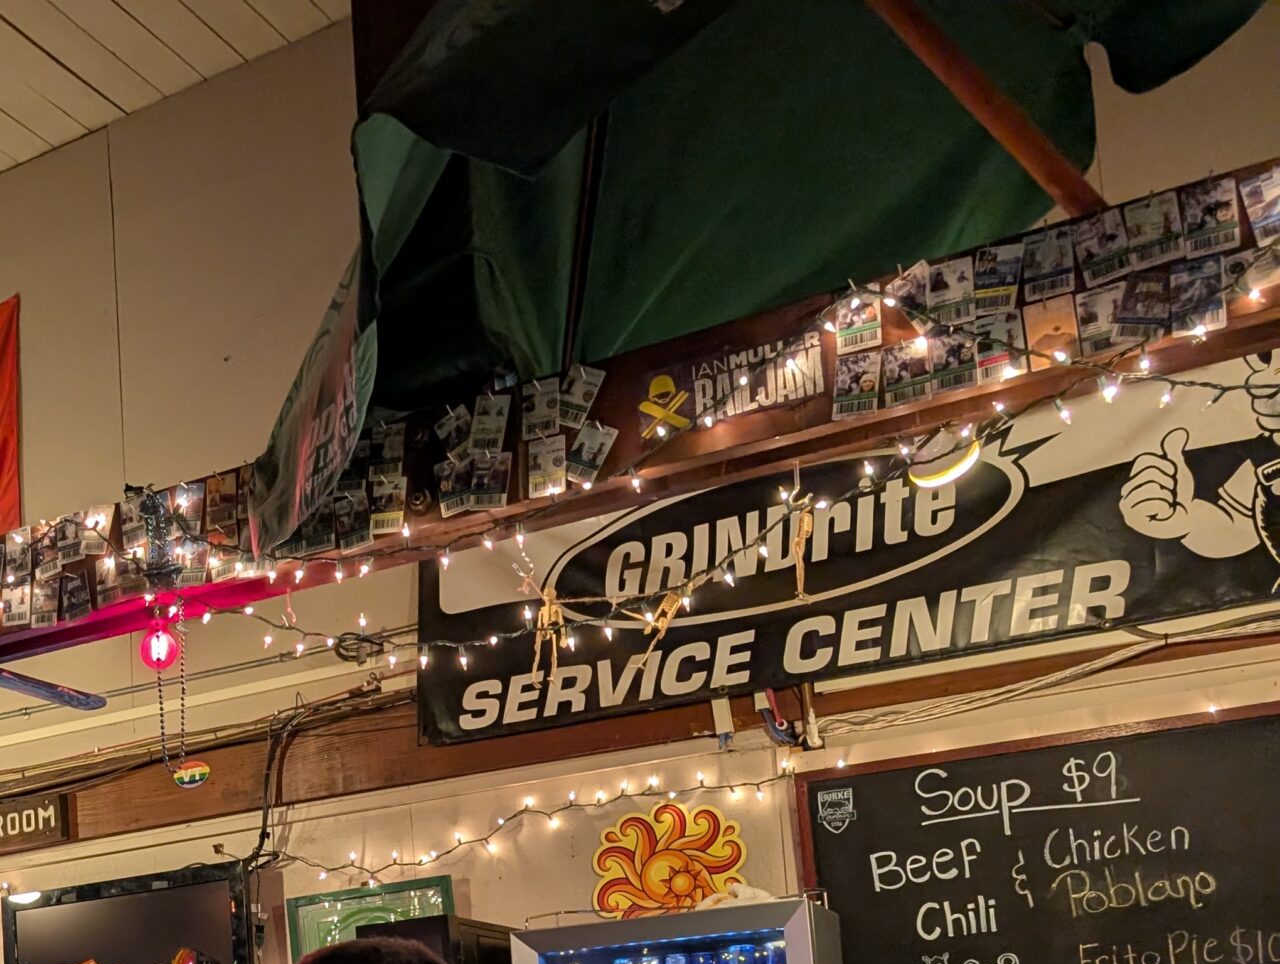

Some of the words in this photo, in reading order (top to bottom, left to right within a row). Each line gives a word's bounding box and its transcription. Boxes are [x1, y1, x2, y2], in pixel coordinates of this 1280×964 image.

[458, 630, 755, 731] SERVICE
[782, 560, 1131, 675] CENTER
[914, 768, 1031, 836] Soup
[1061, 751, 1118, 802] $9
[869, 838, 981, 893] Beef
[1043, 822, 1190, 869] Chicken
[916, 895, 998, 942] Chili
[1050, 868, 1217, 919] Poblano
